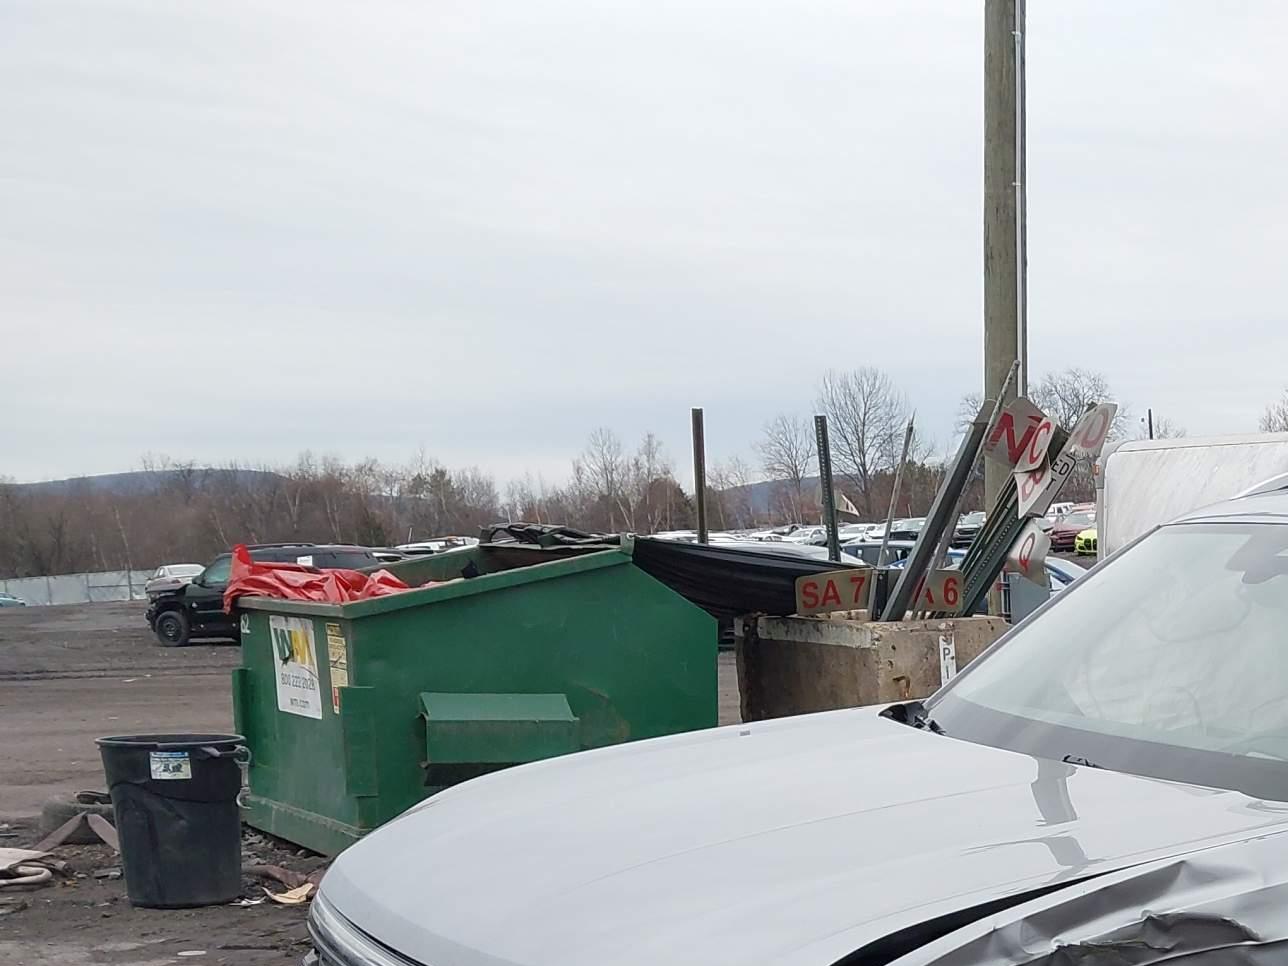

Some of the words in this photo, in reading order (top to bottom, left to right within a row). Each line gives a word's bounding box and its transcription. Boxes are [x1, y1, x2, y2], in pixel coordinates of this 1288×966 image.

[802, 579, 842, 609] SA
[850, 576, 866, 604] 7
[943, 577, 959, 606] 6
